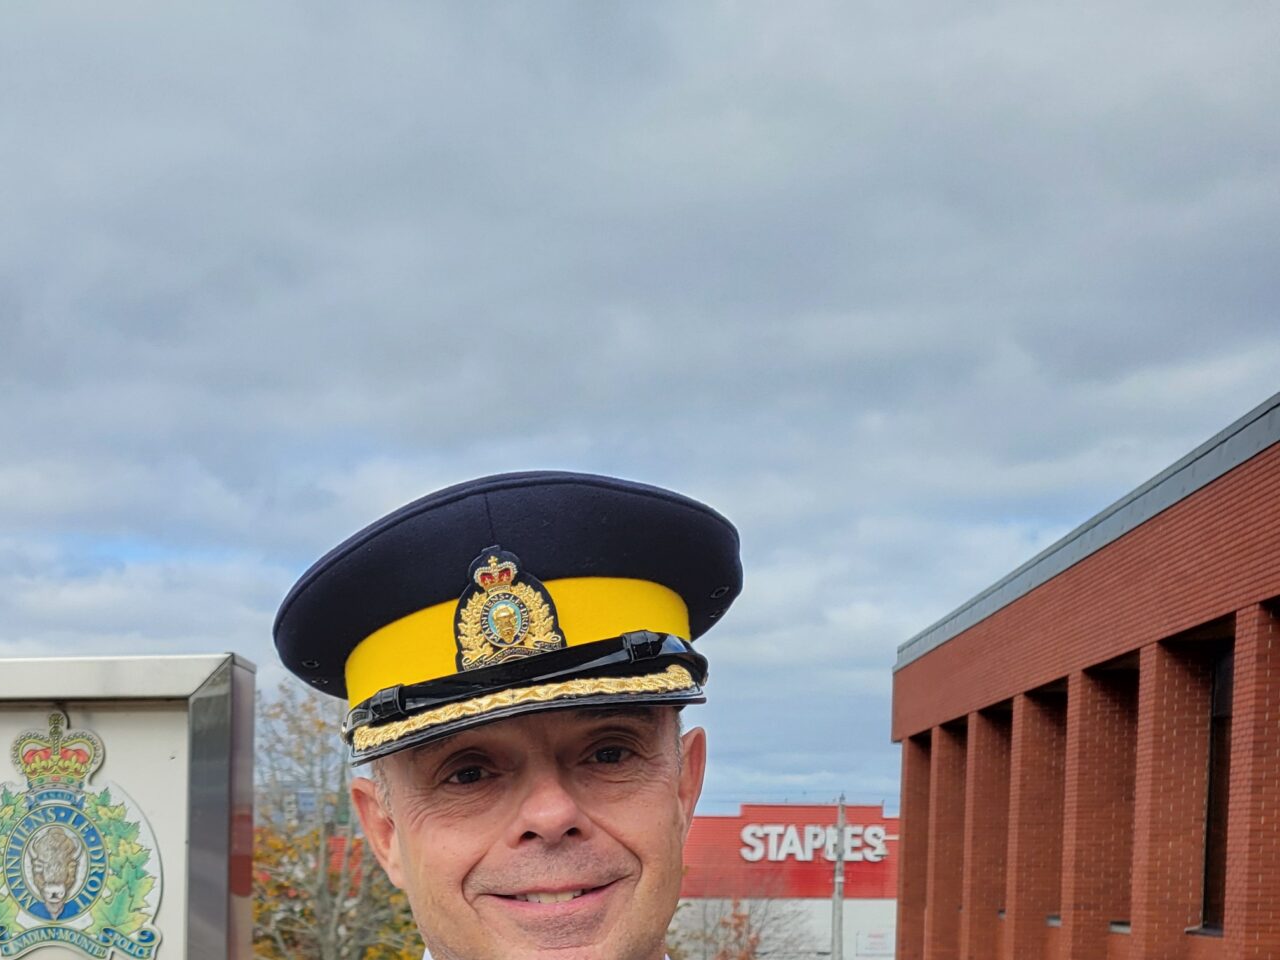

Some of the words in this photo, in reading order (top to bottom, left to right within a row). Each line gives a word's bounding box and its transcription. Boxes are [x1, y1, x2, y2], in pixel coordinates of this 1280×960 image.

[67, 812, 92, 839] LE
[739, 823, 886, 862] STAPLES
[5, 807, 57, 911] MAINTIENS
[74, 845, 106, 914] DROIT
[113, 932, 151, 957] POLICE
